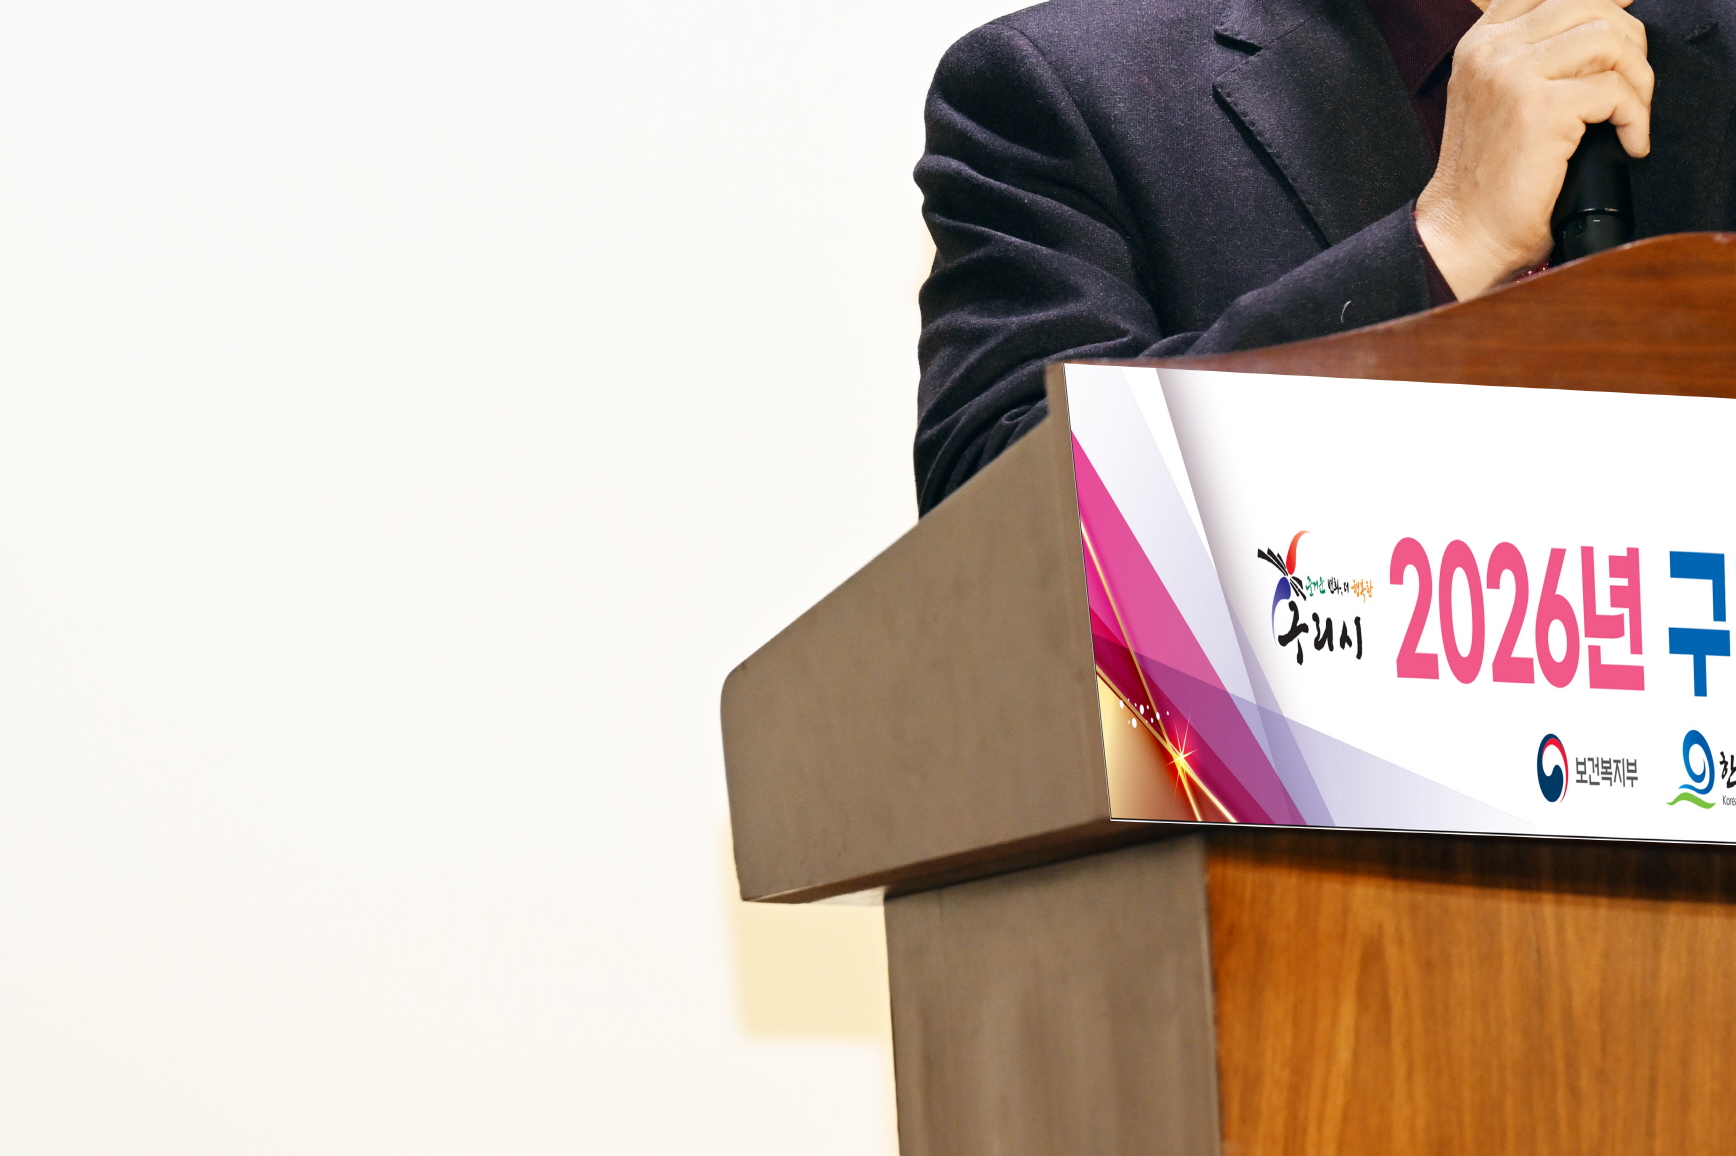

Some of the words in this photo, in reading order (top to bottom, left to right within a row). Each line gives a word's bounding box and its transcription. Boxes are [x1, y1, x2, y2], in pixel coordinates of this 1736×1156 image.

[1278, 600, 1363, 666] 구리시
[1389, 536, 1645, 691] 2026년
[1575, 756, 1639, 788] 보건복지부
